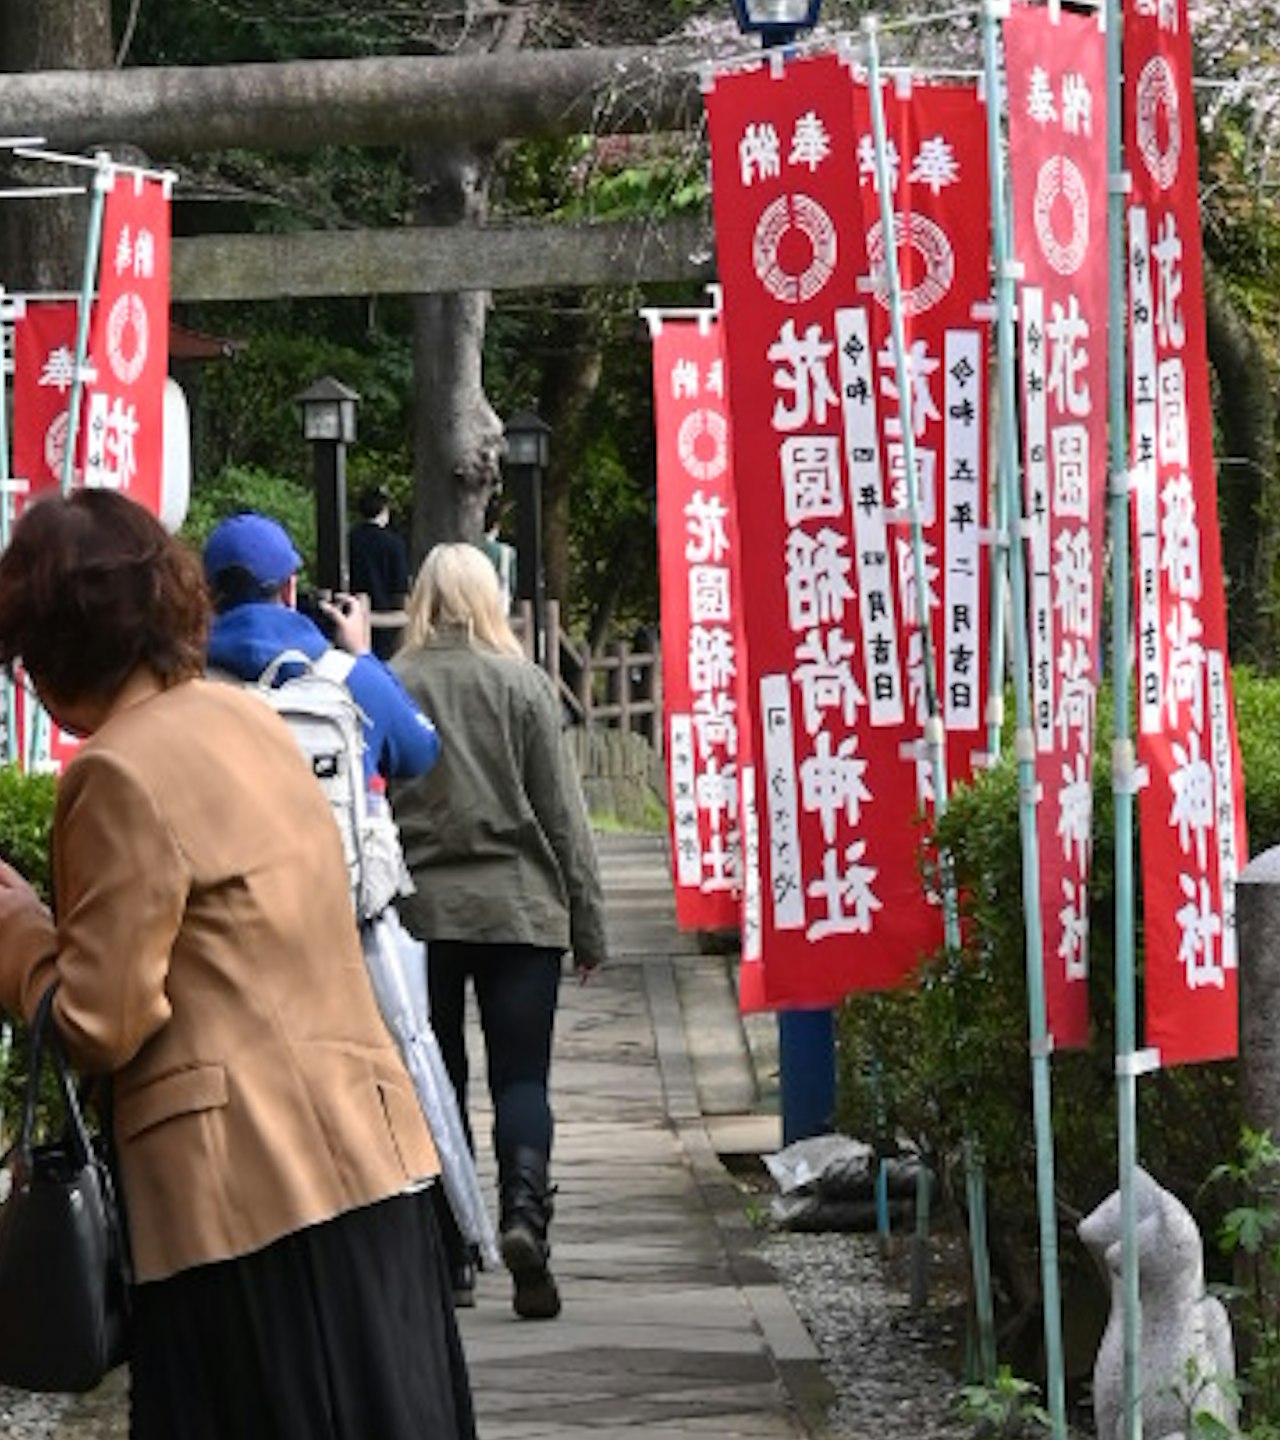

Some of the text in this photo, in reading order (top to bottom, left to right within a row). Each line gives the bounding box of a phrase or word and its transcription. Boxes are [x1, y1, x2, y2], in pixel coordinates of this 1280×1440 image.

[1151, 211, 1226, 990] 花園稲荷神社
